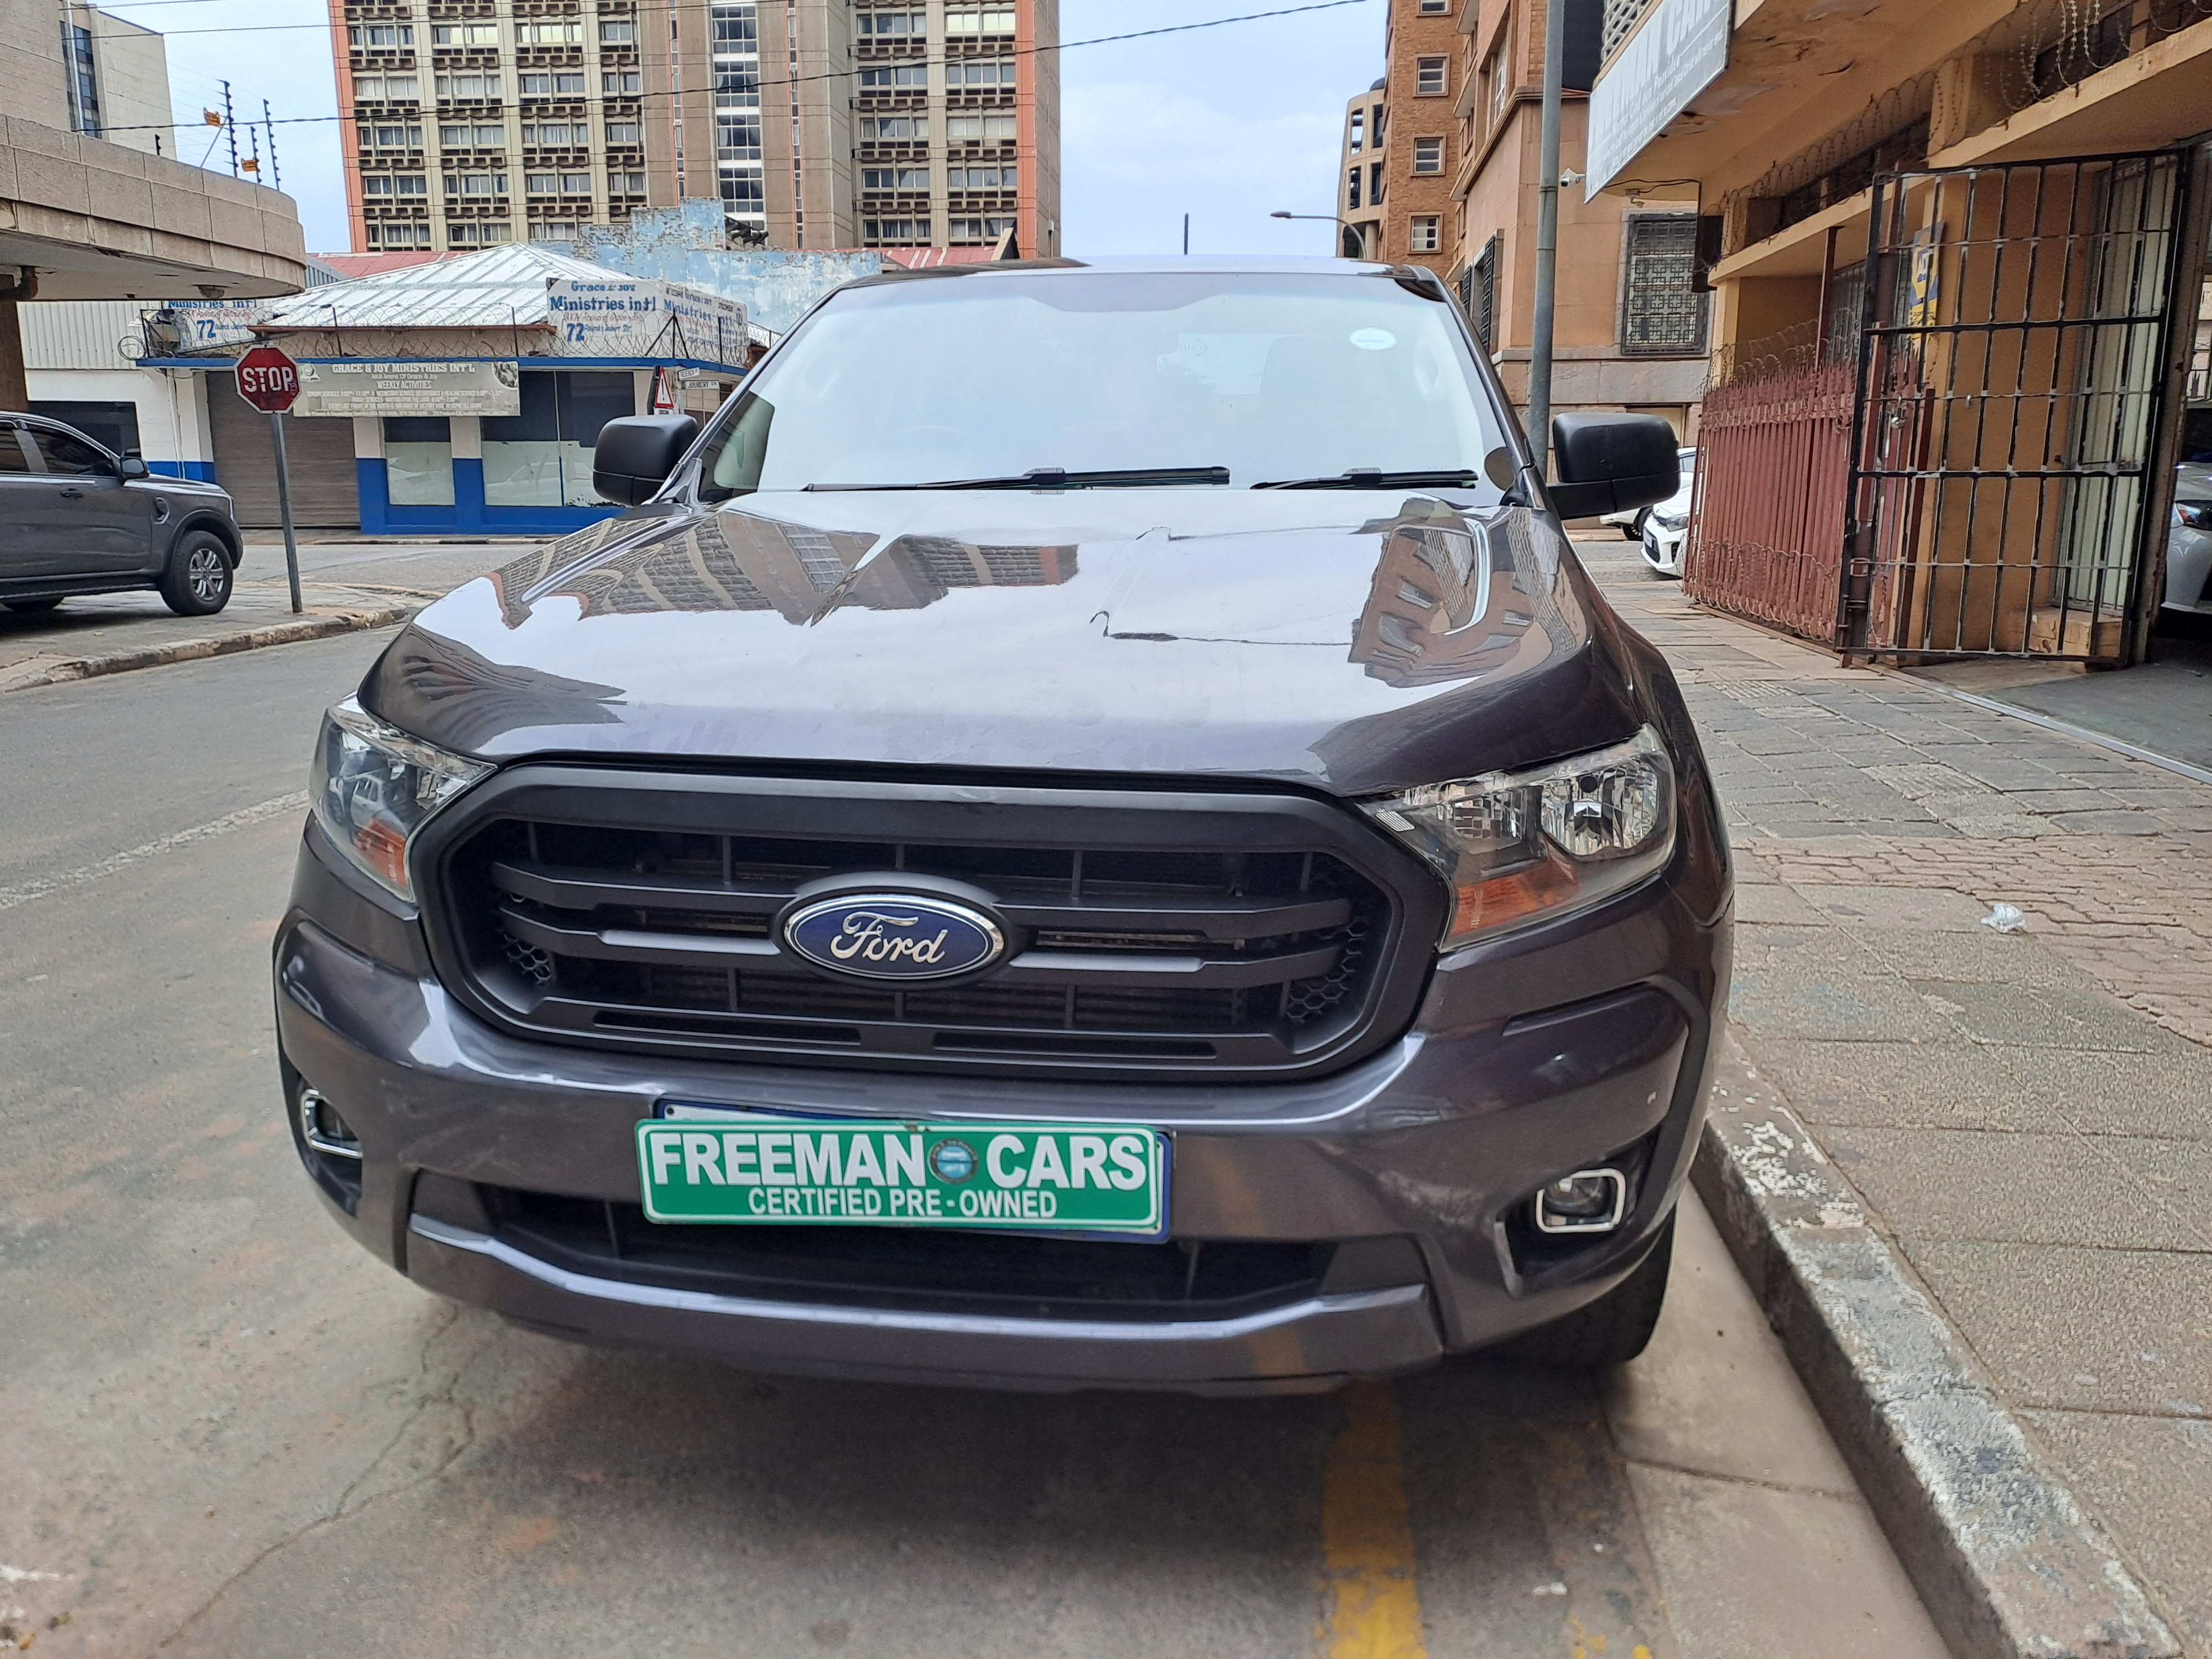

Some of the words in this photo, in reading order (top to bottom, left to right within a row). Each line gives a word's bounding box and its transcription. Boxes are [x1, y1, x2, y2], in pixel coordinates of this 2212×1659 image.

[571, 280, 606, 292] Grace
[549, 295, 625, 311] Ministries
[197, 319, 217, 340] 72
[567, 322, 585, 342] 72
[332, 363, 364, 373] GRACE
[365, 363, 372, 373] &
[373, 363, 389, 373] JOY
[392, 363, 447, 373] MINISTRIES
[449, 363, 476, 373] INT'L
[242, 366, 294, 393] STOP
[377, 380, 400, 389] WEEKLY
[401, 380, 432, 389] ACTIVITIES
[830, 911, 948, 964] Ford
[649, 1132, 927, 1187] FREEMAN
[985, 1134, 1147, 1191] CARS
[748, 1187, 881, 1216] CERTIFIED
[890, 1189, 942, 1217] PRE
[959, 1189, 1057, 1218] OWNED
